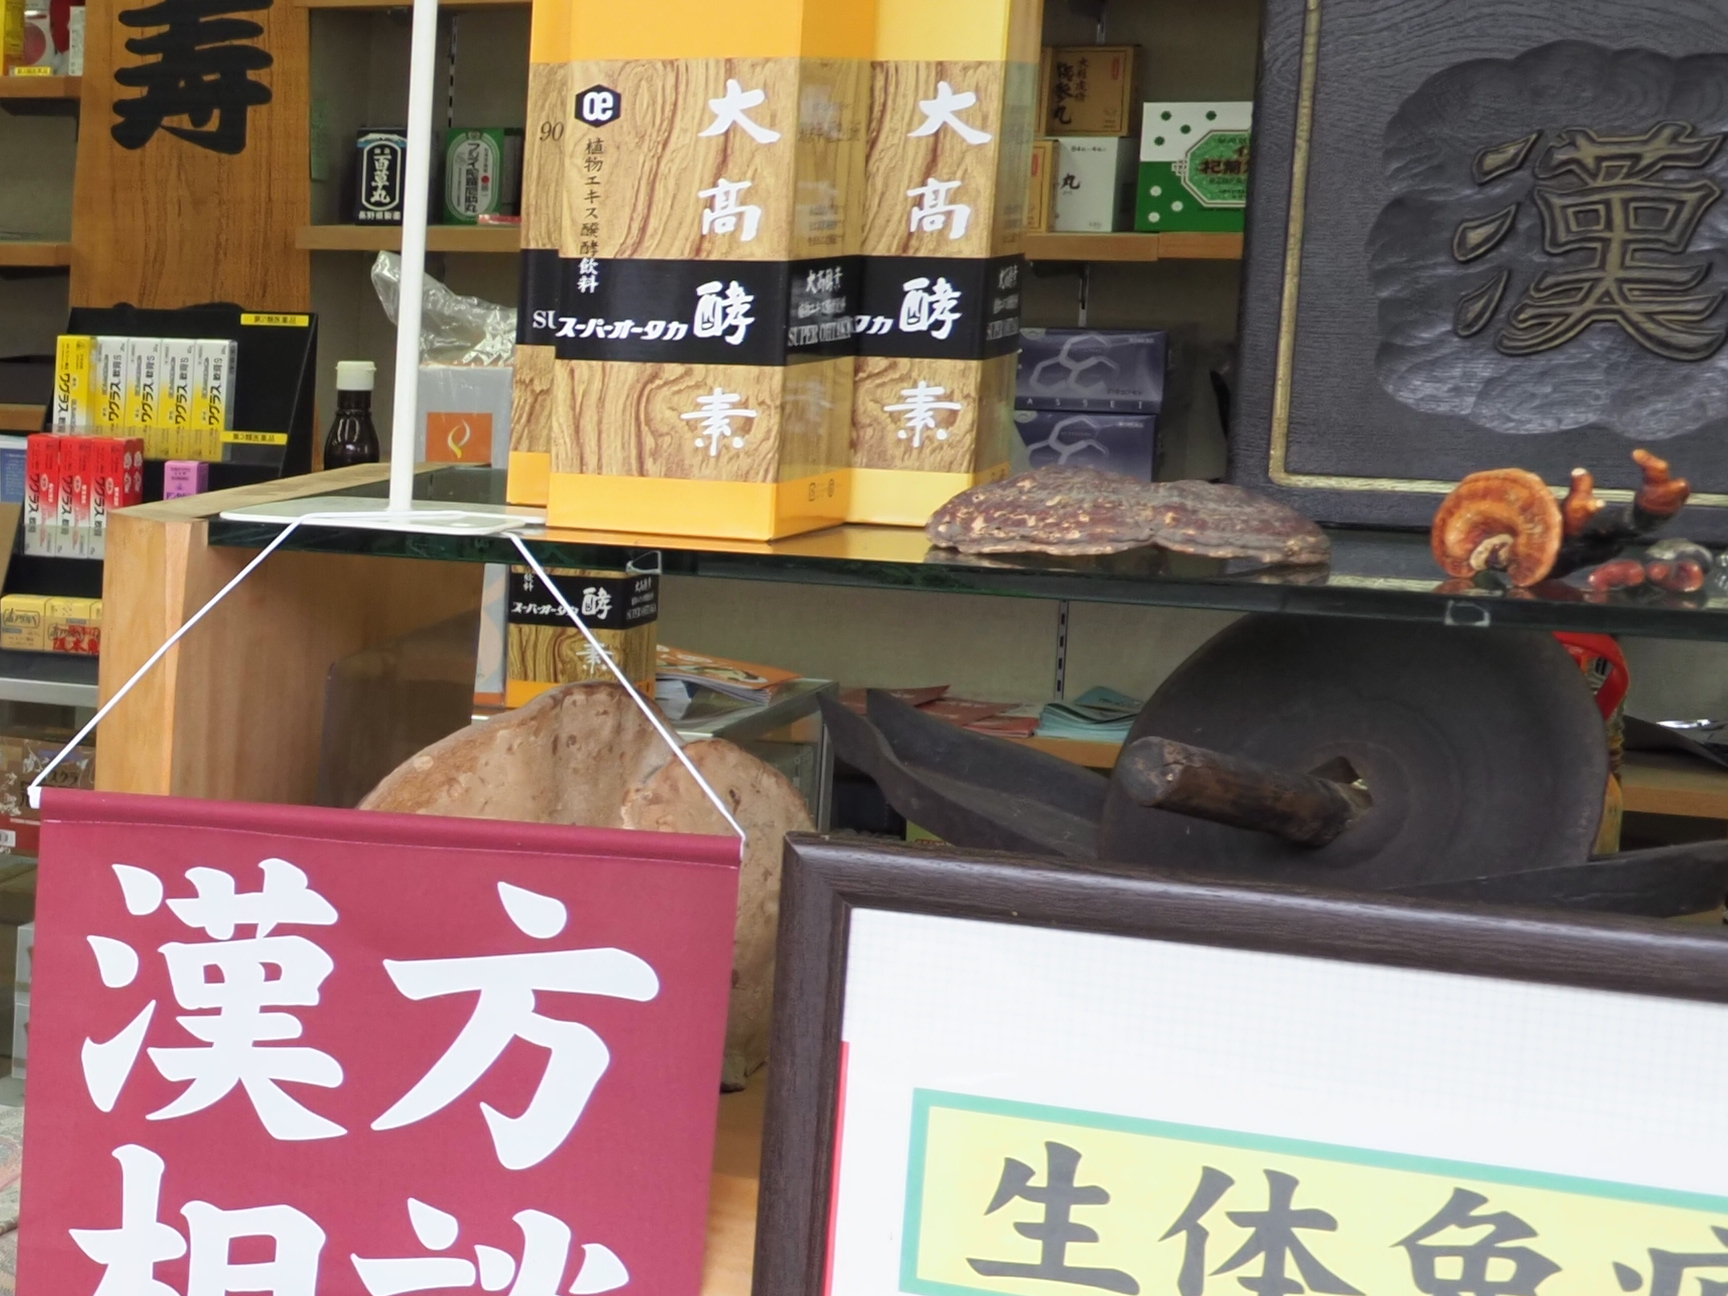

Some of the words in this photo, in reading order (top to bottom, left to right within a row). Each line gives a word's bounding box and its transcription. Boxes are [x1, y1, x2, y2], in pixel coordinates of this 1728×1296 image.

[539, 120, 564, 142] 90
[372, 154, 392, 205] 百草丸
[1453, 120, 1728, 363] 漢
[555, 315, 689, 342] スーパーオータカ
[80, 856, 662, 1171] 漢方
